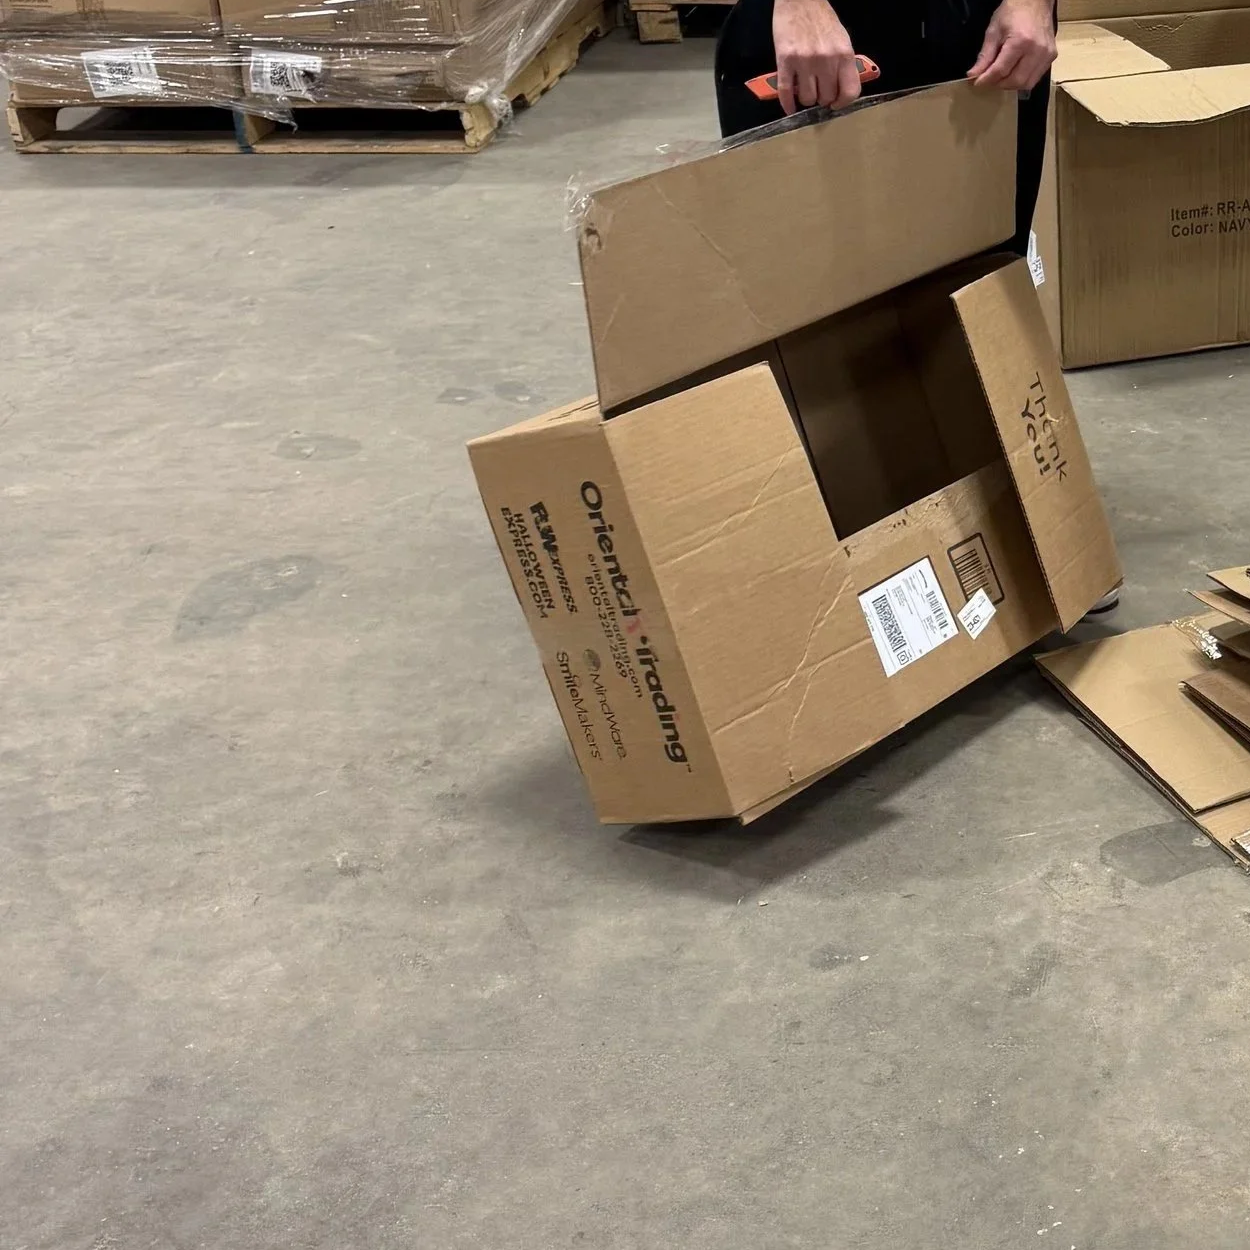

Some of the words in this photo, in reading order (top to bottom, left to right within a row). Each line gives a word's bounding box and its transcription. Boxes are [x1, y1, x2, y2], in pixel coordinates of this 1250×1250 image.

[1170, 204, 1213, 221] Item#:
[1171, 222, 1214, 237] Color:
[501, 507, 549, 619] EXPRESS.COM
[513, 512, 556, 610] HALLOWEEN
[580, 481, 642, 617] Oriental
[588, 553, 643, 698] orientaltrading.com
